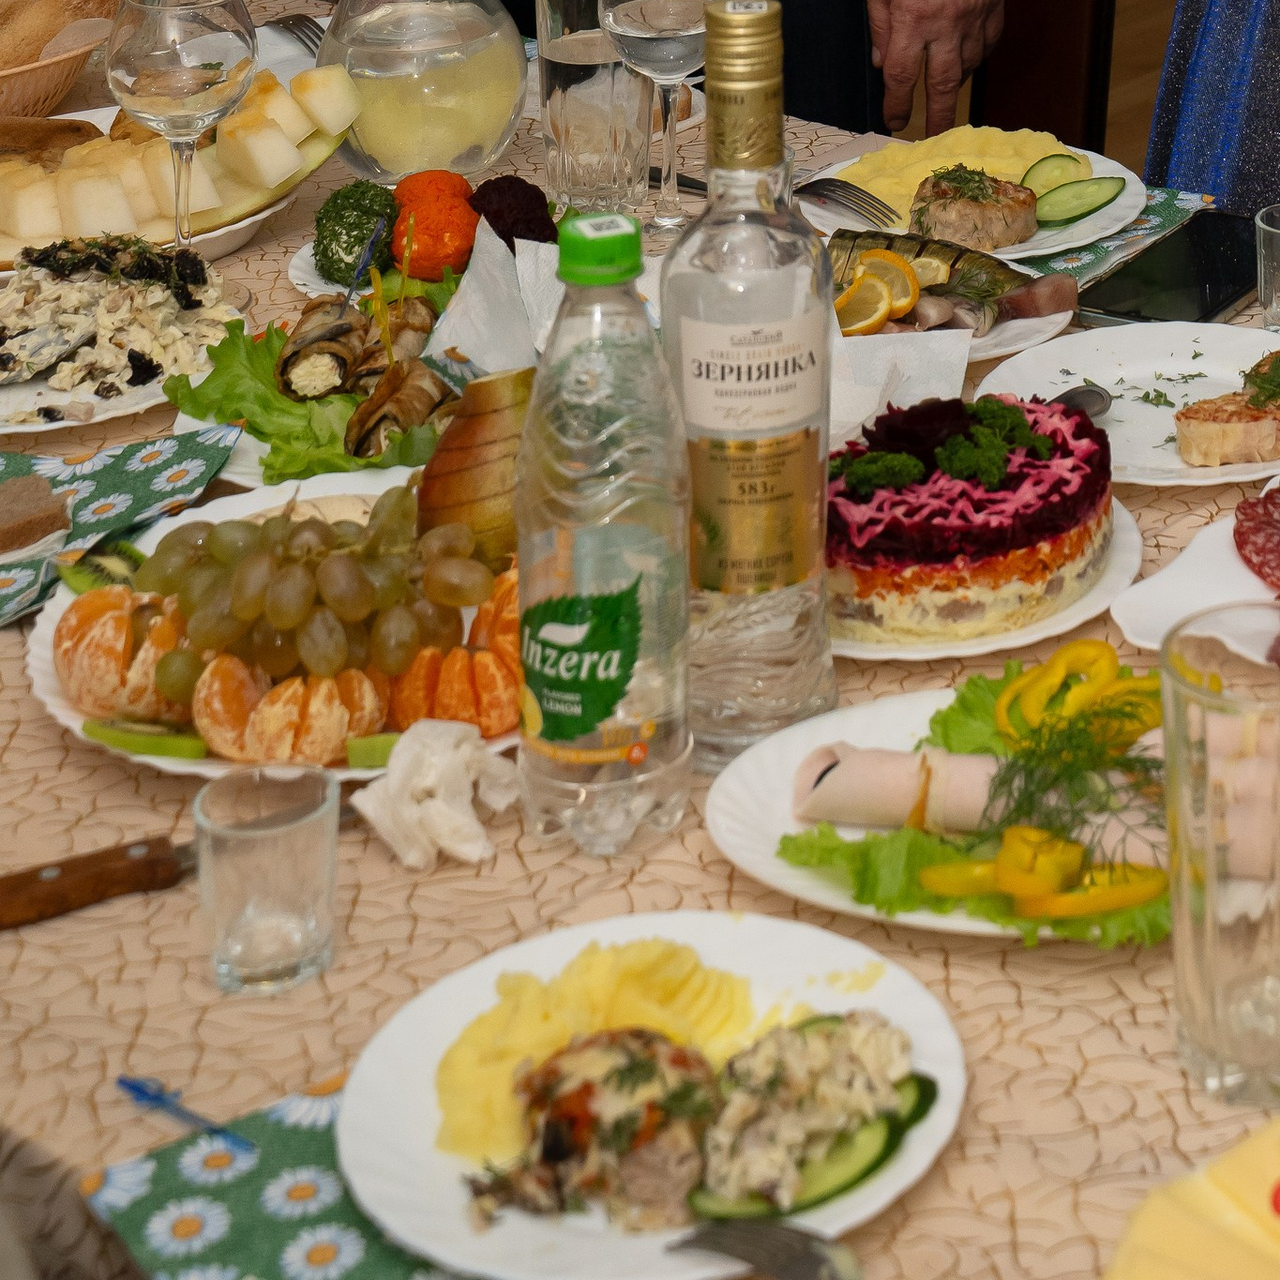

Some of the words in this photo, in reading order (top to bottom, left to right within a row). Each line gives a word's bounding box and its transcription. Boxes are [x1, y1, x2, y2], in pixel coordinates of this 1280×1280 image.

[692, 350, 817, 383] ЗЕРНЯНКА
[522, 625, 622, 681] Inzera
[543, 697, 582, 717] LEMON
